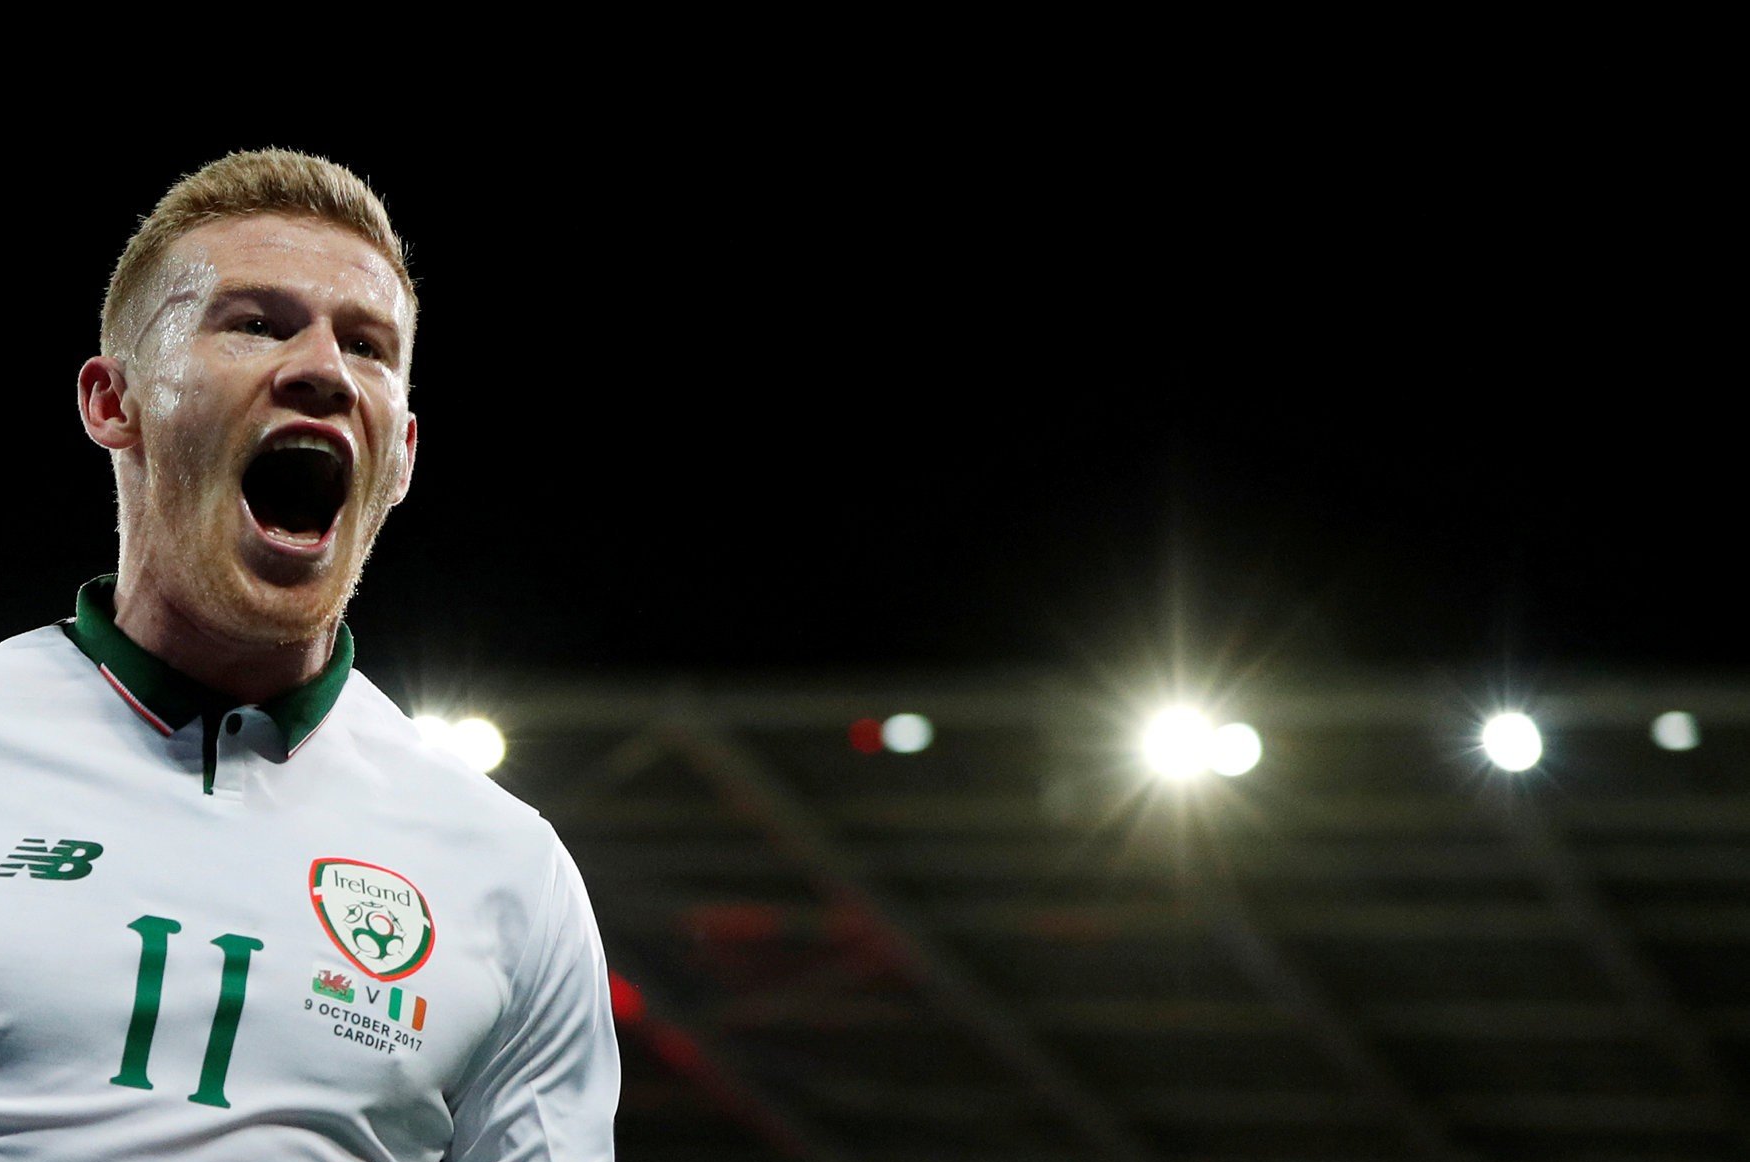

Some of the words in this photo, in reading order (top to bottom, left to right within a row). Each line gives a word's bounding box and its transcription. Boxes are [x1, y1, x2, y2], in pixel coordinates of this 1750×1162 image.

[333, 870, 412, 908] Ireland
[109, 914, 264, 1109] 11
[366, 985, 381, 1005] V
[304, 998, 313, 1010] 9
[318, 1003, 391, 1038] OCTOBER
[394, 1030, 423, 1052] 2017
[333, 1024, 397, 1055] CARDIFF
